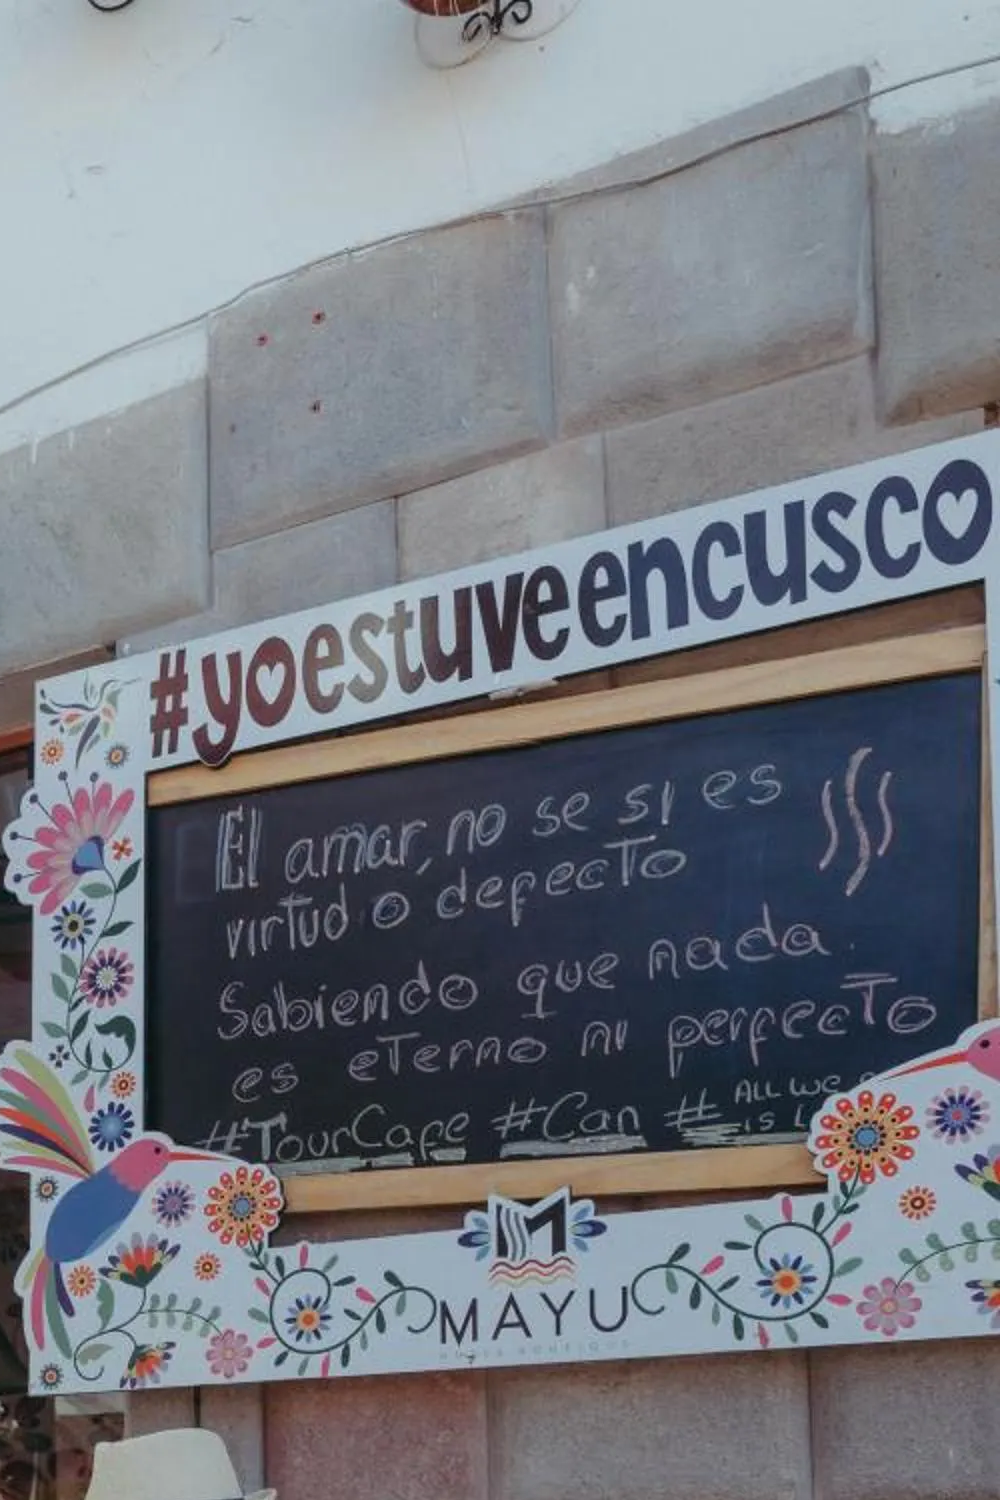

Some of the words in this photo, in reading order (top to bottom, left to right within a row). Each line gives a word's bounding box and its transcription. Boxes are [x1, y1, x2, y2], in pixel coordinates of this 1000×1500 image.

[150, 458, 993, 766] #yoestuveencusco
[215, 804, 262, 892] El
[446, 803, 506, 854] no
[532, 791, 591, 837] se
[702, 764, 783, 810] es
[372, 891, 410, 929] o
[217, 959, 479, 1040] Sabiendo
[517, 953, 620, 1019] que
[232, 1062, 299, 1103] es
[440, 1285, 629, 1347] MAYU
